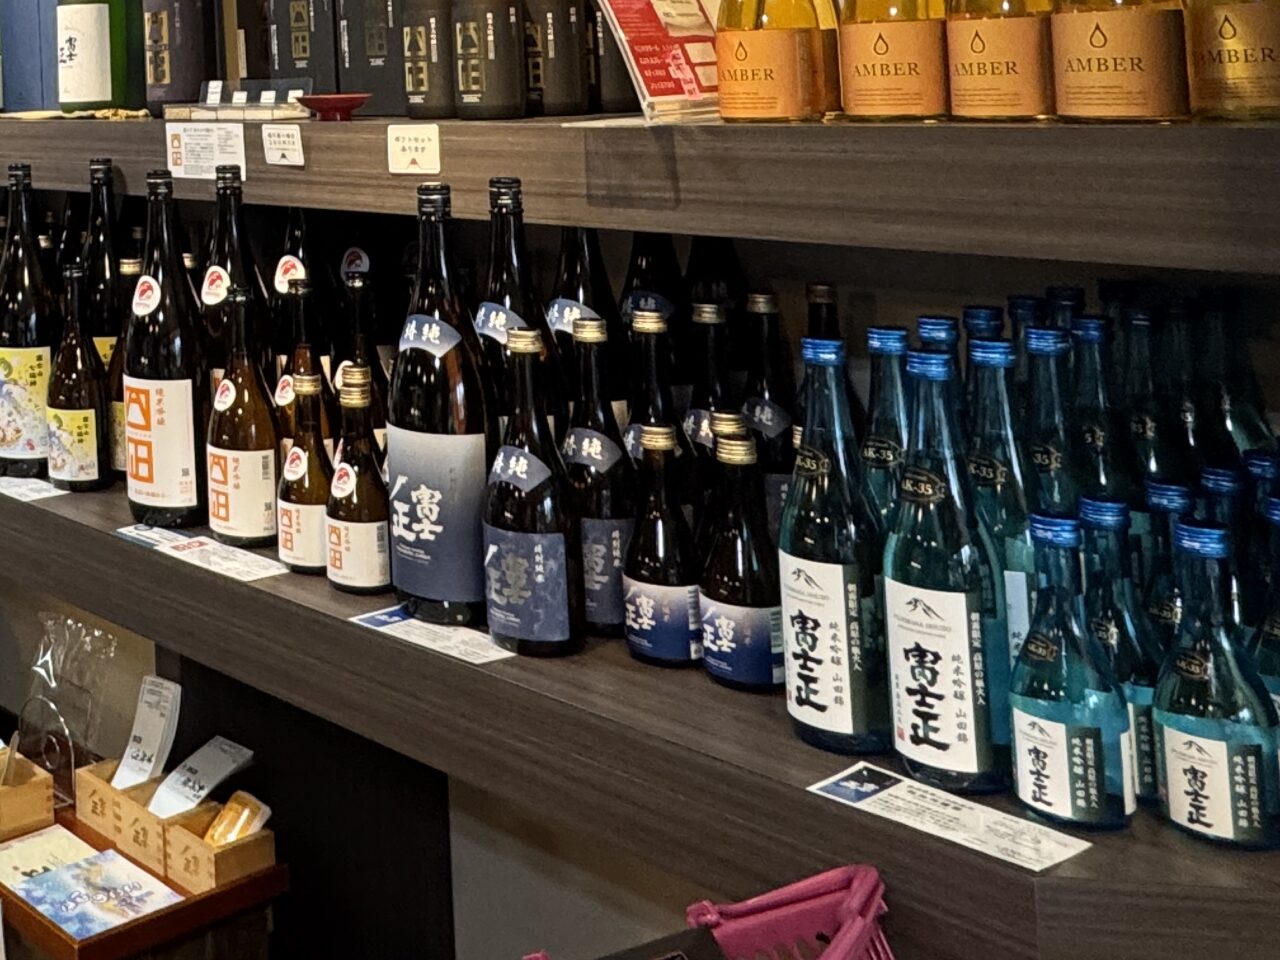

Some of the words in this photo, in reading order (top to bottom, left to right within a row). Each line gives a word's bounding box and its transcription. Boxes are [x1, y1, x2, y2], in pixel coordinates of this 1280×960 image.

[852, 62, 920, 78] AMBER
[953, 60, 1020, 76] AMBER
[1065, 55, 1145, 73] AMBER
[720, 68, 775, 81] AMBER
[951, 653, 966, 701] 純米吟醸
[956, 708, 968, 744] 山田錦
